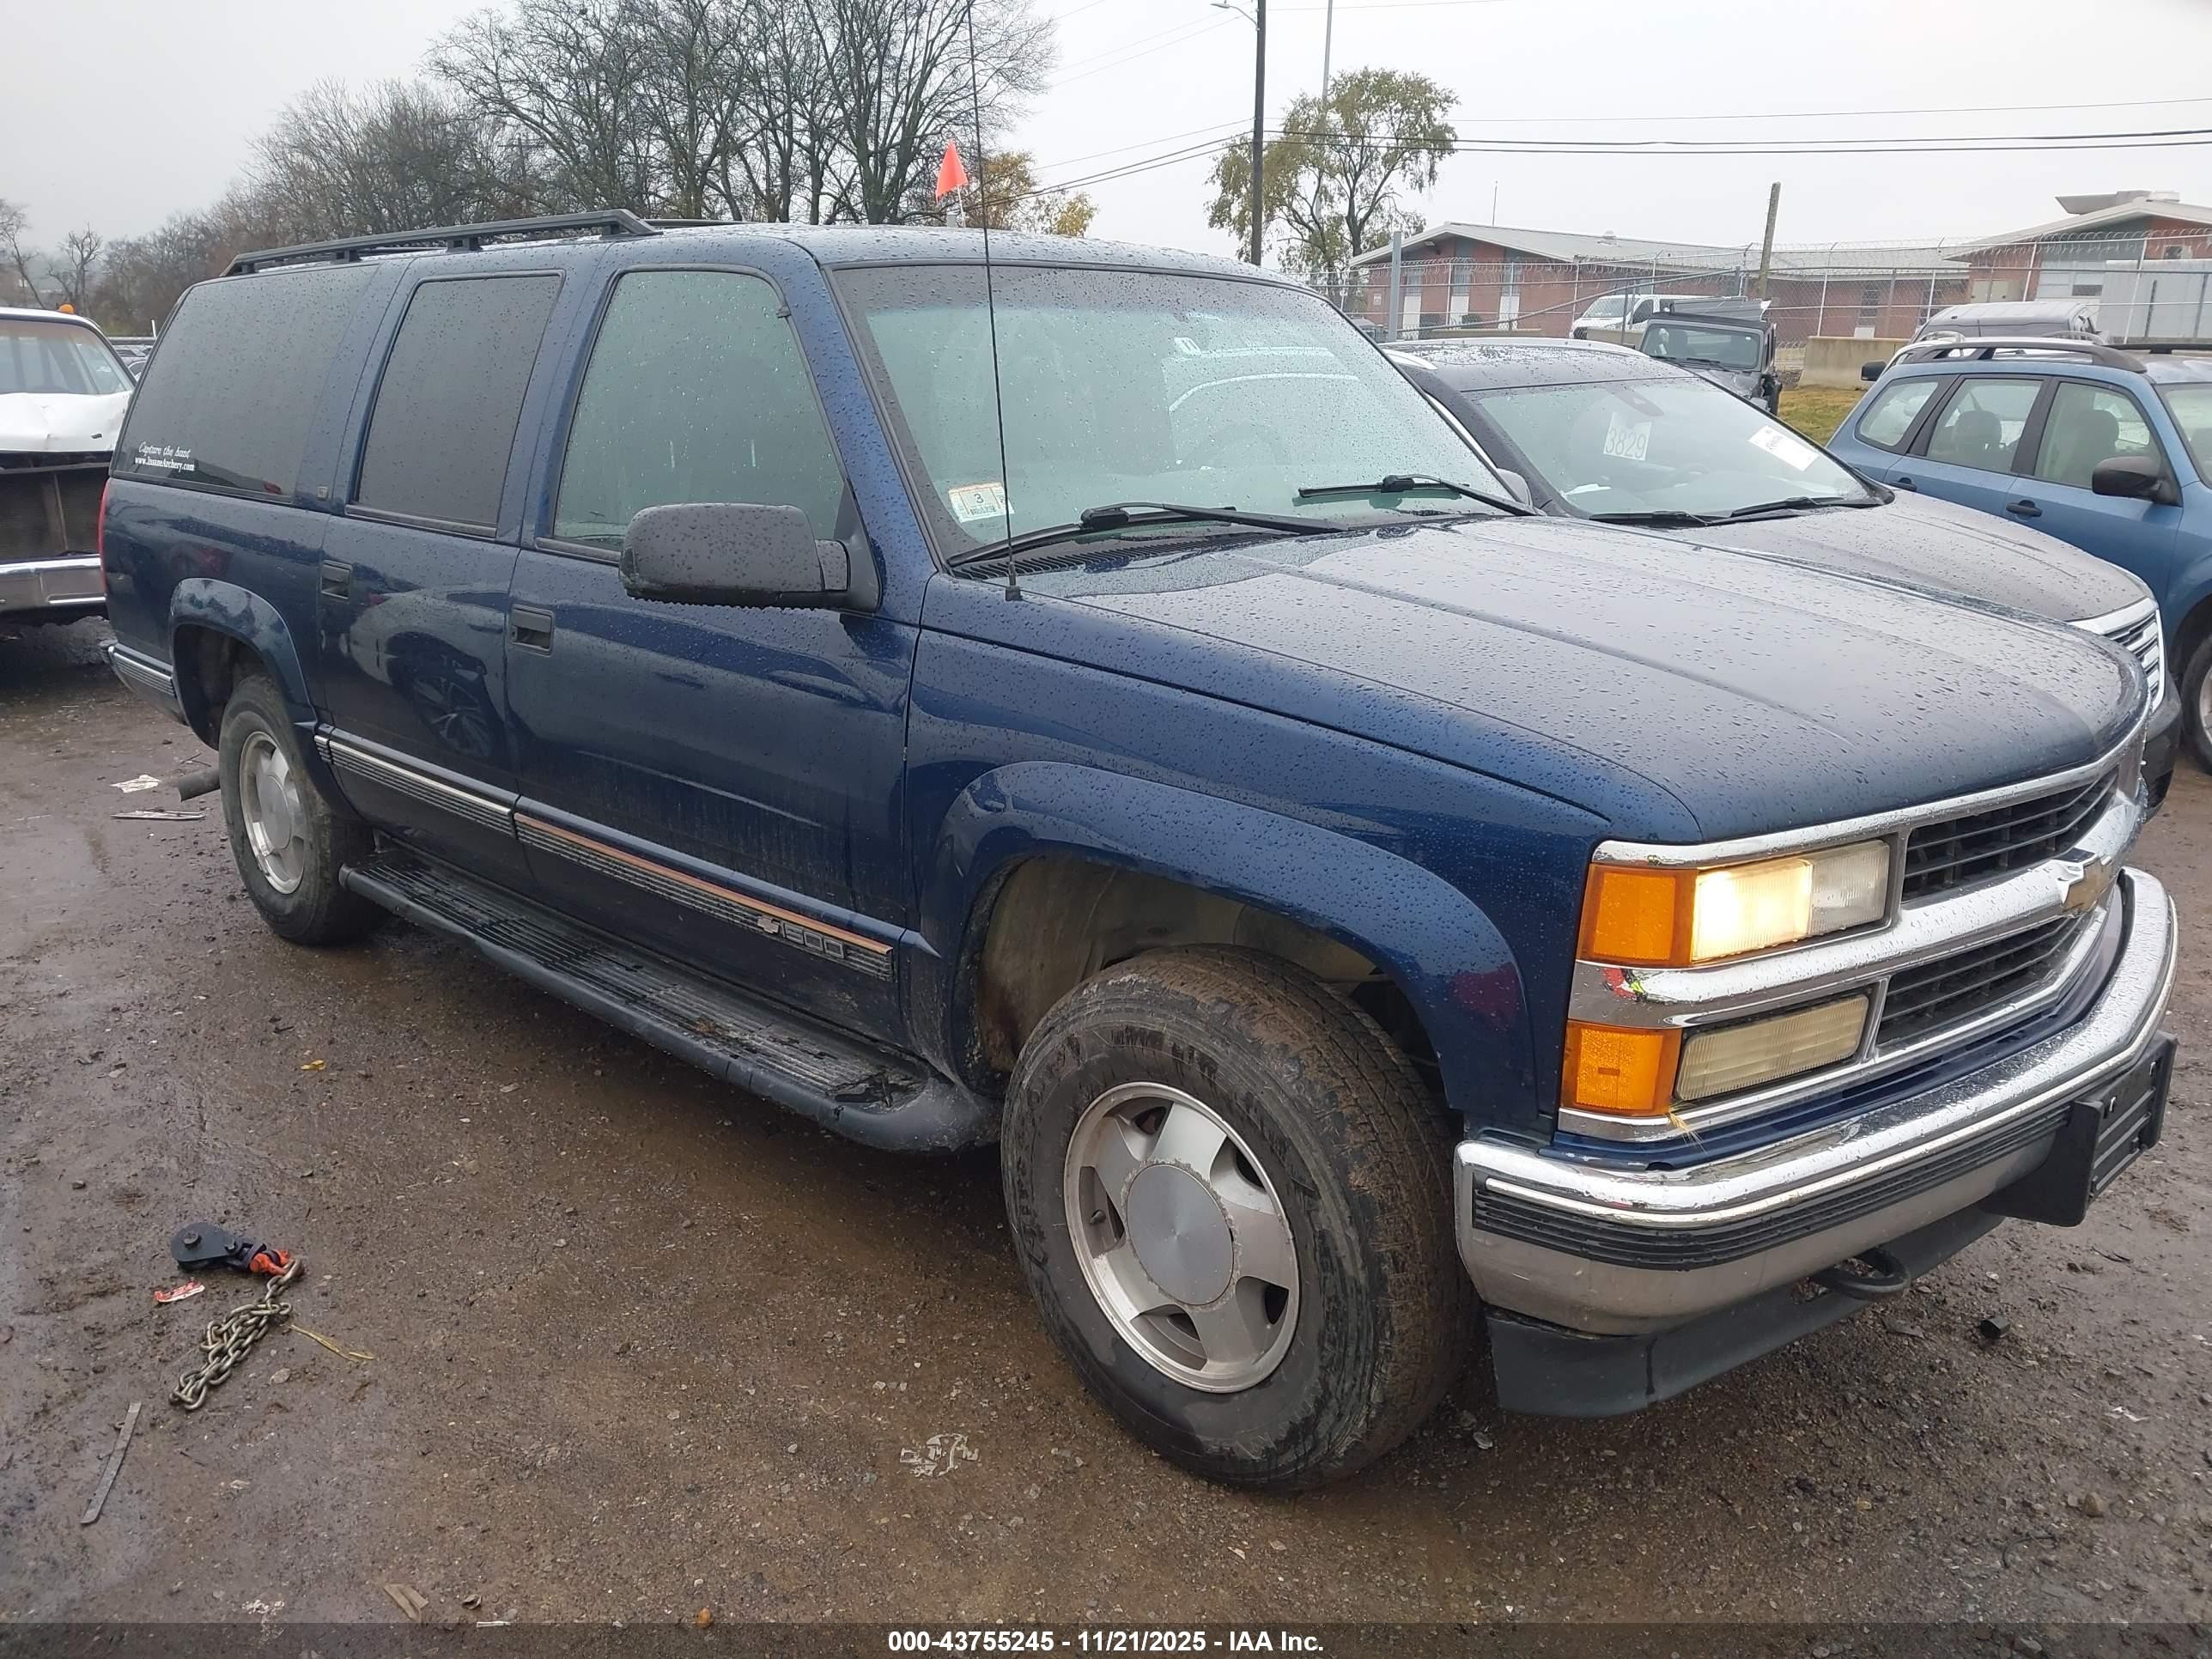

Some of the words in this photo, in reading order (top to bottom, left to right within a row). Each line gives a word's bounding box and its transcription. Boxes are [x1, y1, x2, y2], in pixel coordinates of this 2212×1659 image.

[138, 441, 162, 456] Capture
[163, 446, 173, 456] the
[1605, 428, 1646, 459] 3829
[974, 493, 984, 503] 3
